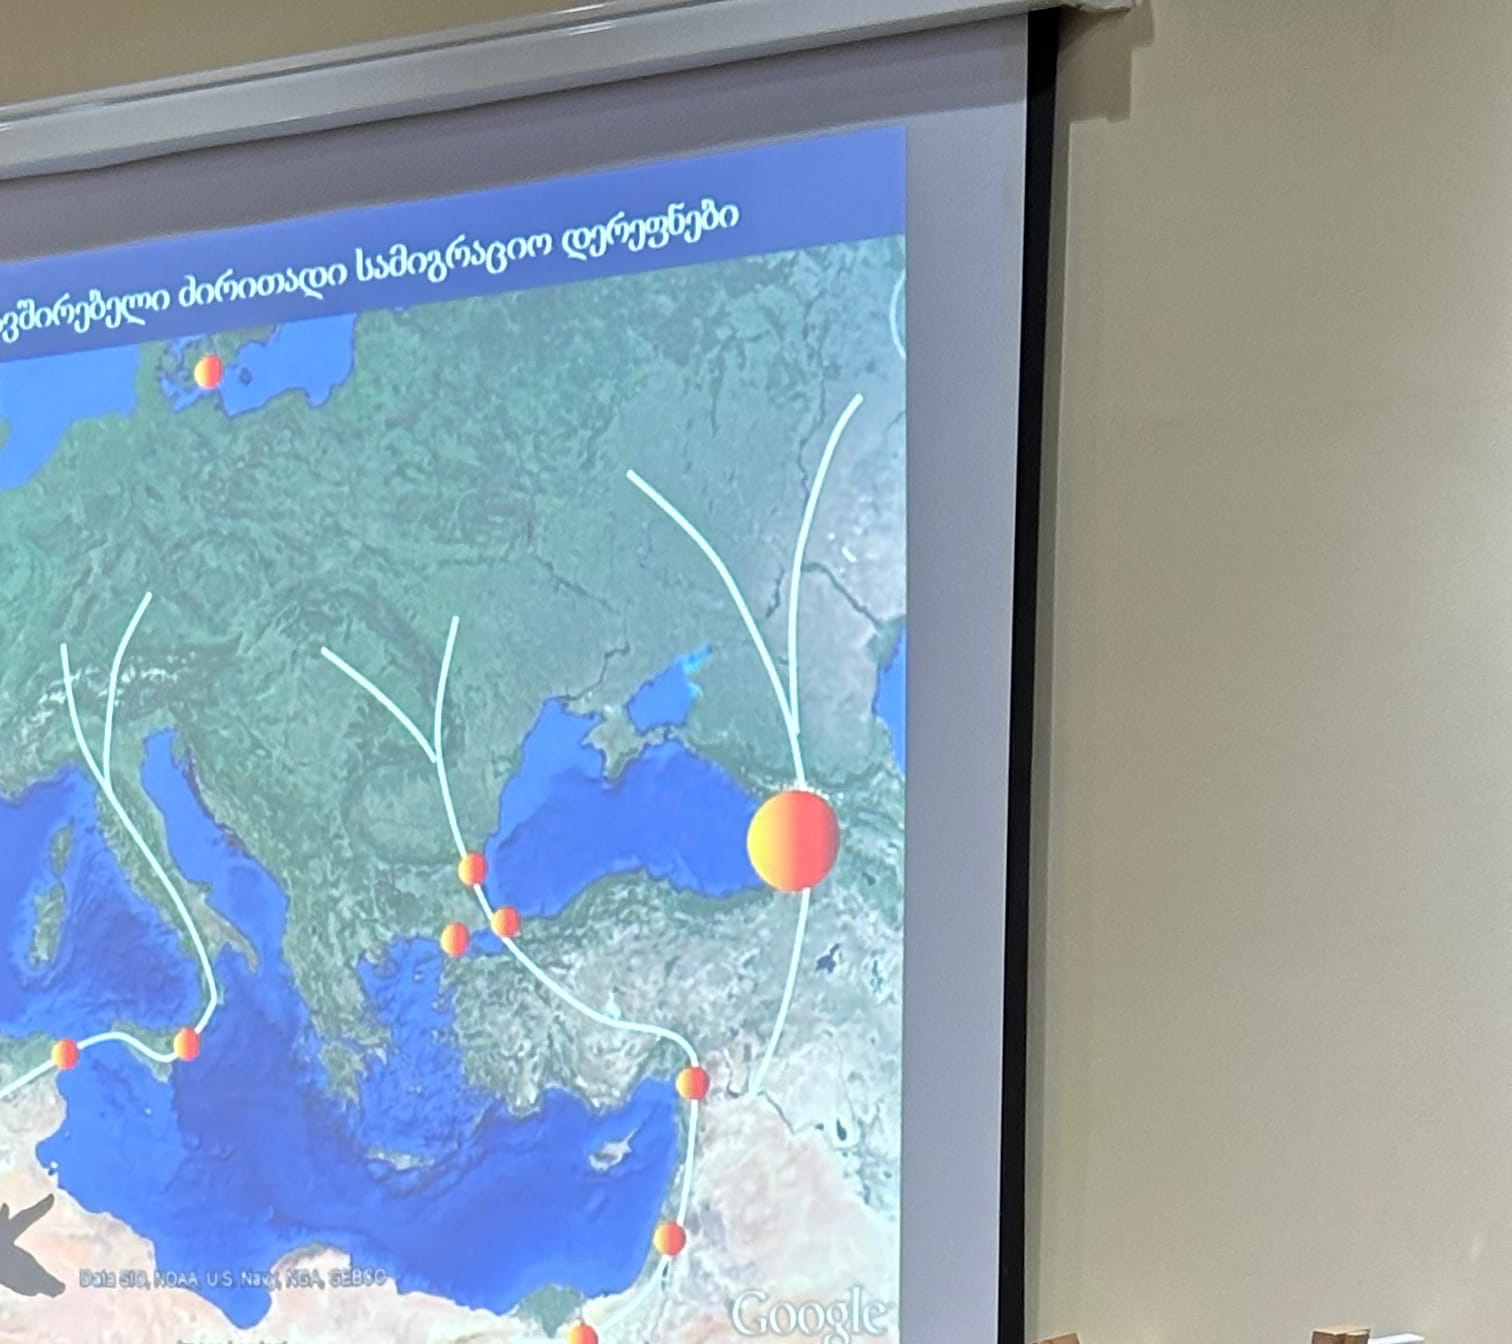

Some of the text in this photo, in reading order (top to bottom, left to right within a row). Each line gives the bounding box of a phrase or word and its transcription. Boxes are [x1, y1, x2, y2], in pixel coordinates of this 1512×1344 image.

[178, 261, 348, 309] ძირითადი
[354, 233, 553, 284] სამიგრაციო
[561, 198, 740, 261] დერეფნები
